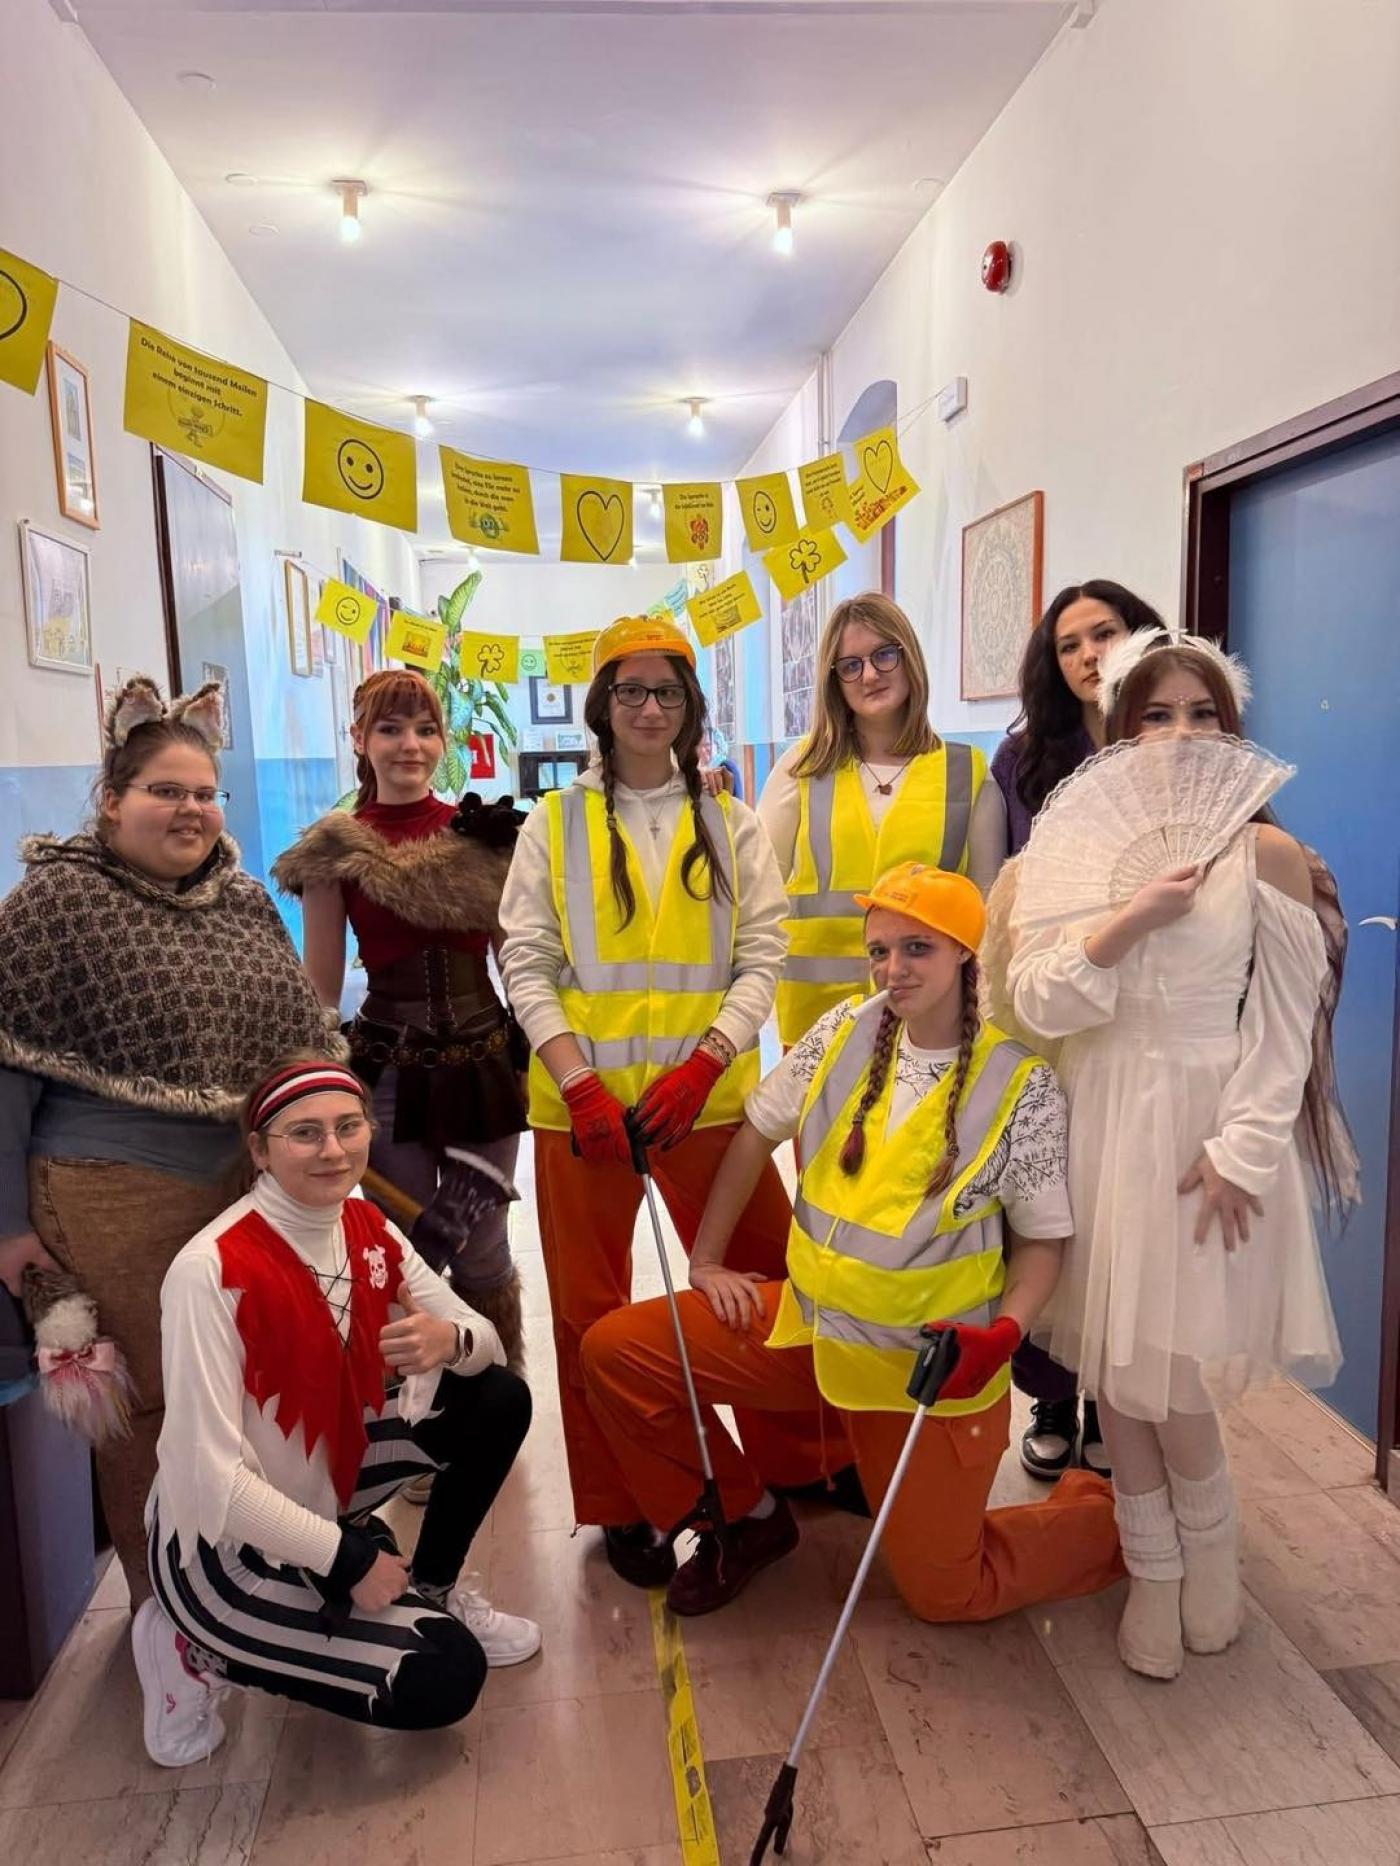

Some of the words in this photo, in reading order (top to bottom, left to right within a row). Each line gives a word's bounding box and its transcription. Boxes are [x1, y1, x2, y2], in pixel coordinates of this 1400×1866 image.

[141, 337, 155, 351] Die
[178, 358, 193, 371] von
[194, 366, 228, 385] tausend
[152, 372, 176, 389] einem
[178, 384, 212, 405] einzigen
[206, 383, 221, 396] mit
